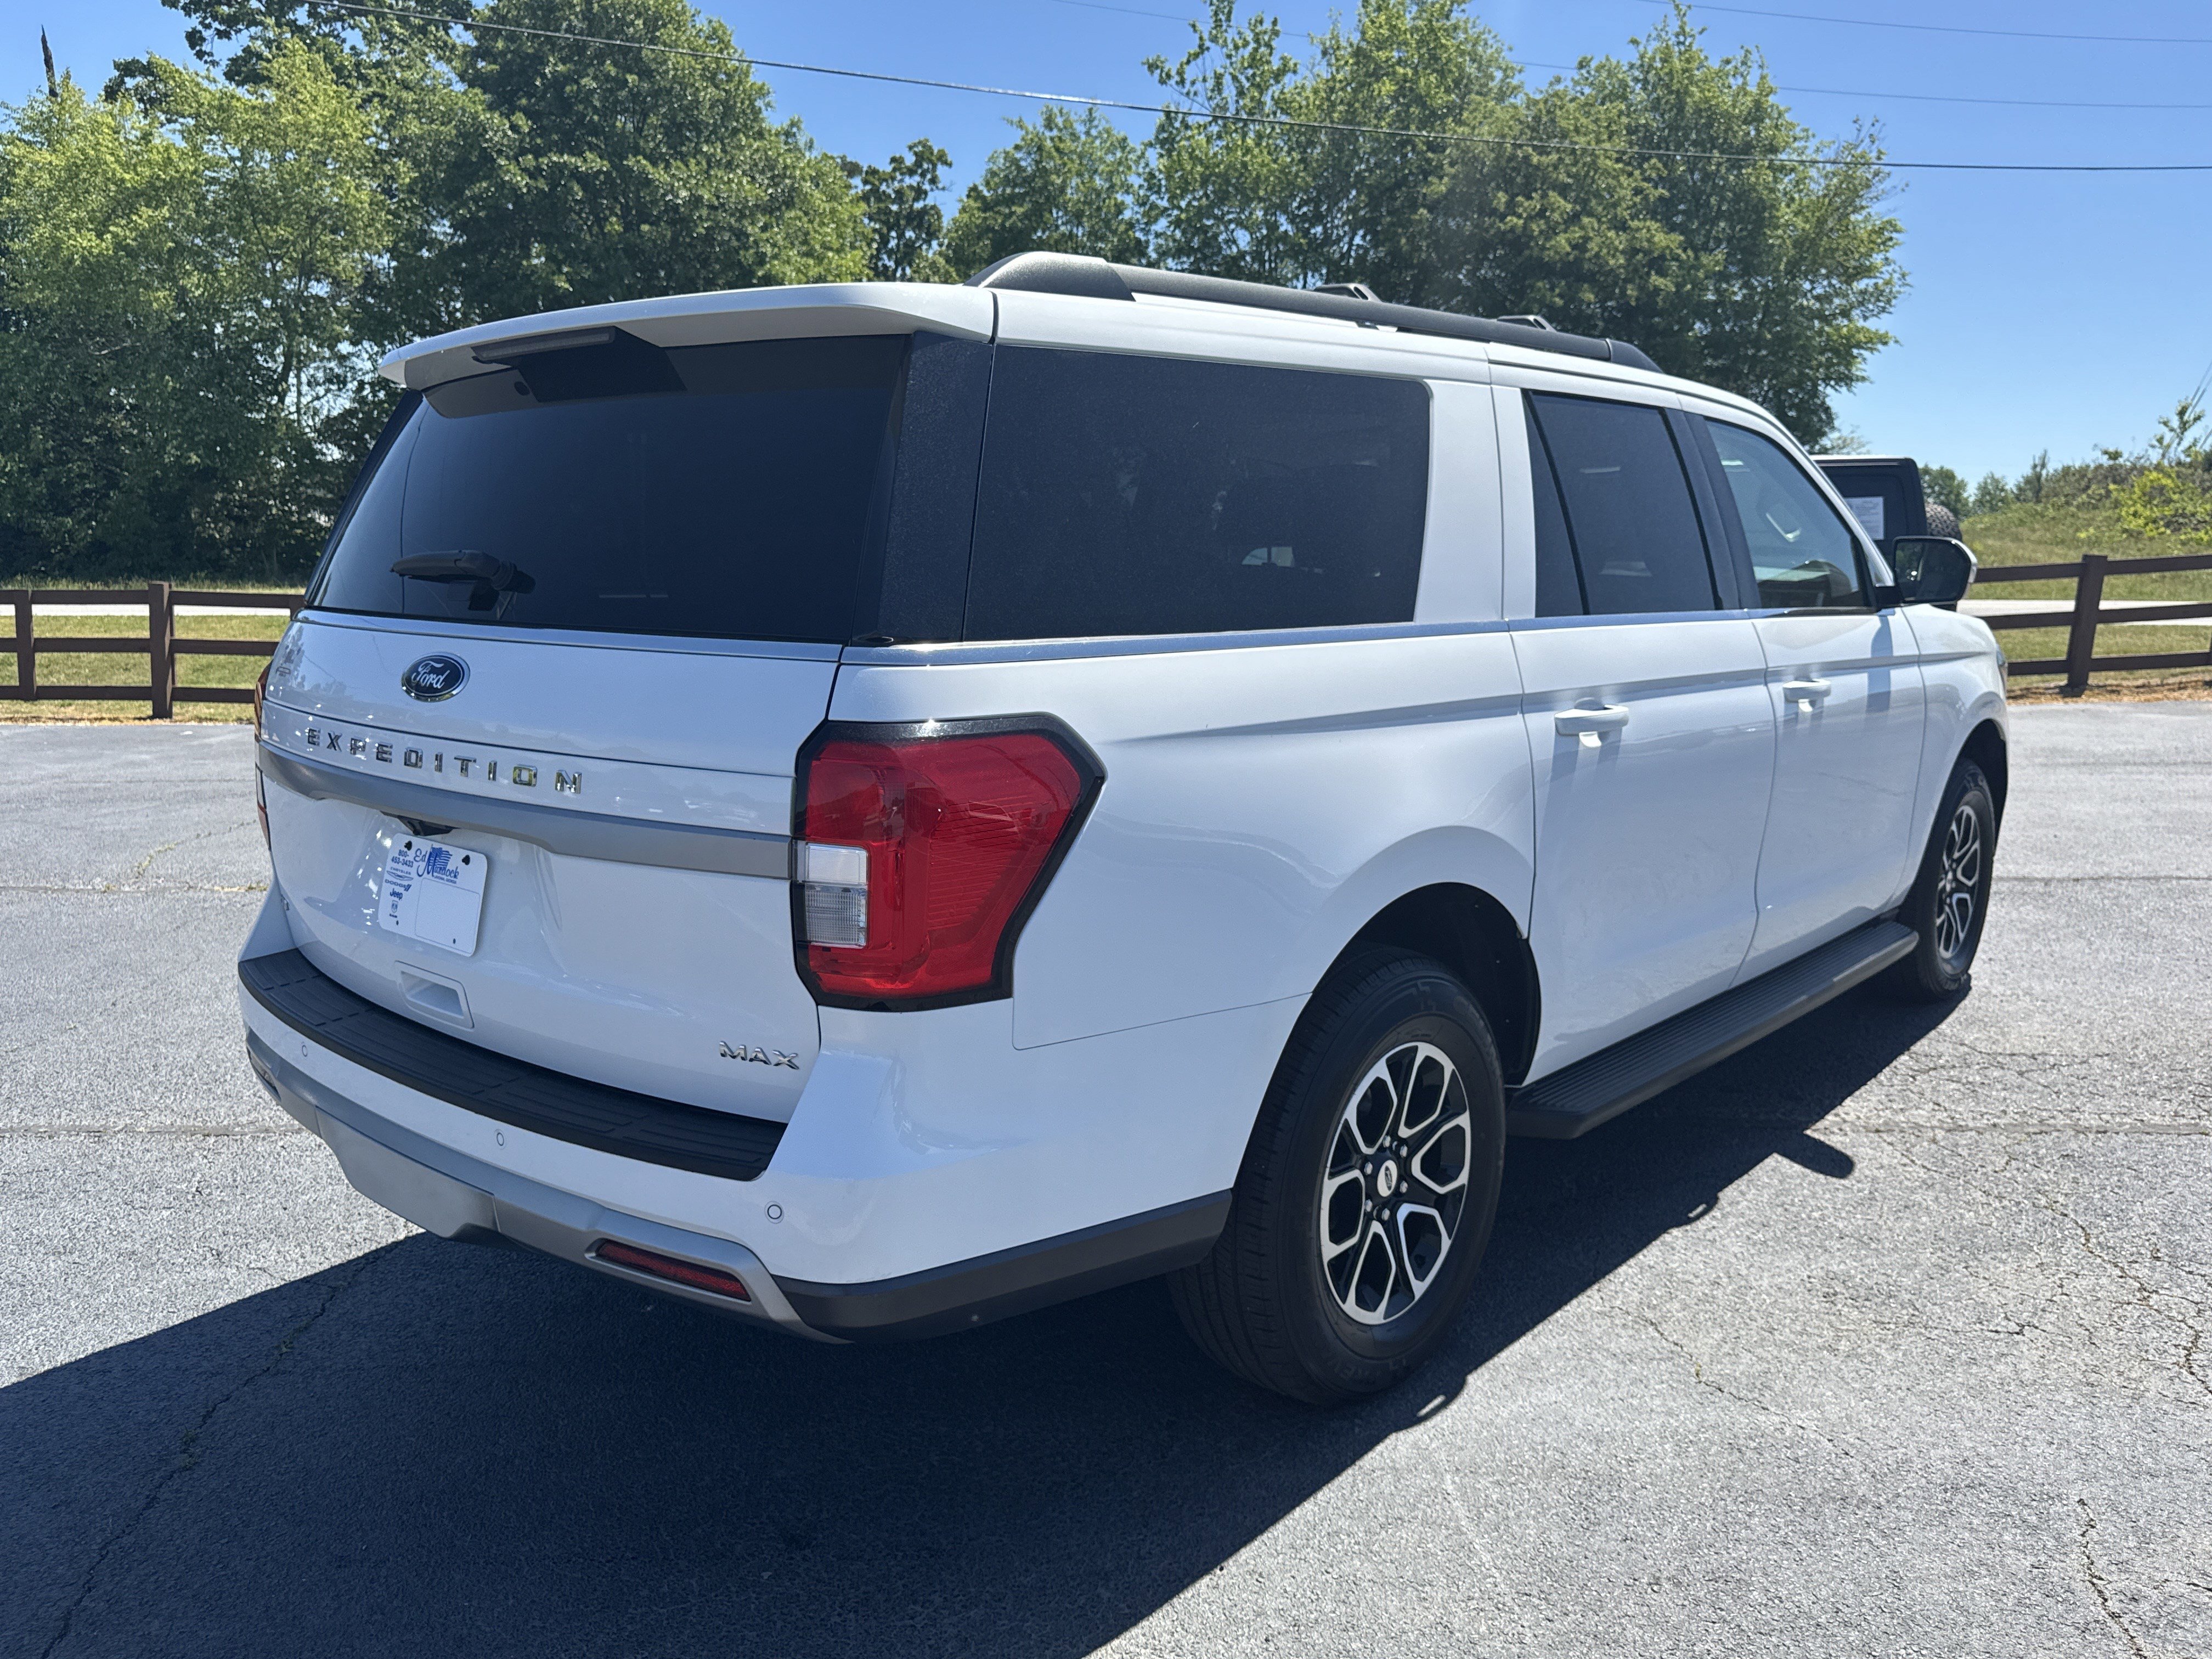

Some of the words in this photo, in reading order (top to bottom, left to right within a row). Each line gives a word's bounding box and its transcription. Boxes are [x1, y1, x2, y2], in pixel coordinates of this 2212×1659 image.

[412, 661, 447, 689] Ford
[307, 728, 583, 794] EXPEDITION
[414, 848, 428, 862] Ed
[385, 879, 407, 889] DODGE
[390, 888, 403, 900] Jeep
[719, 1040, 799, 1070] MAX
